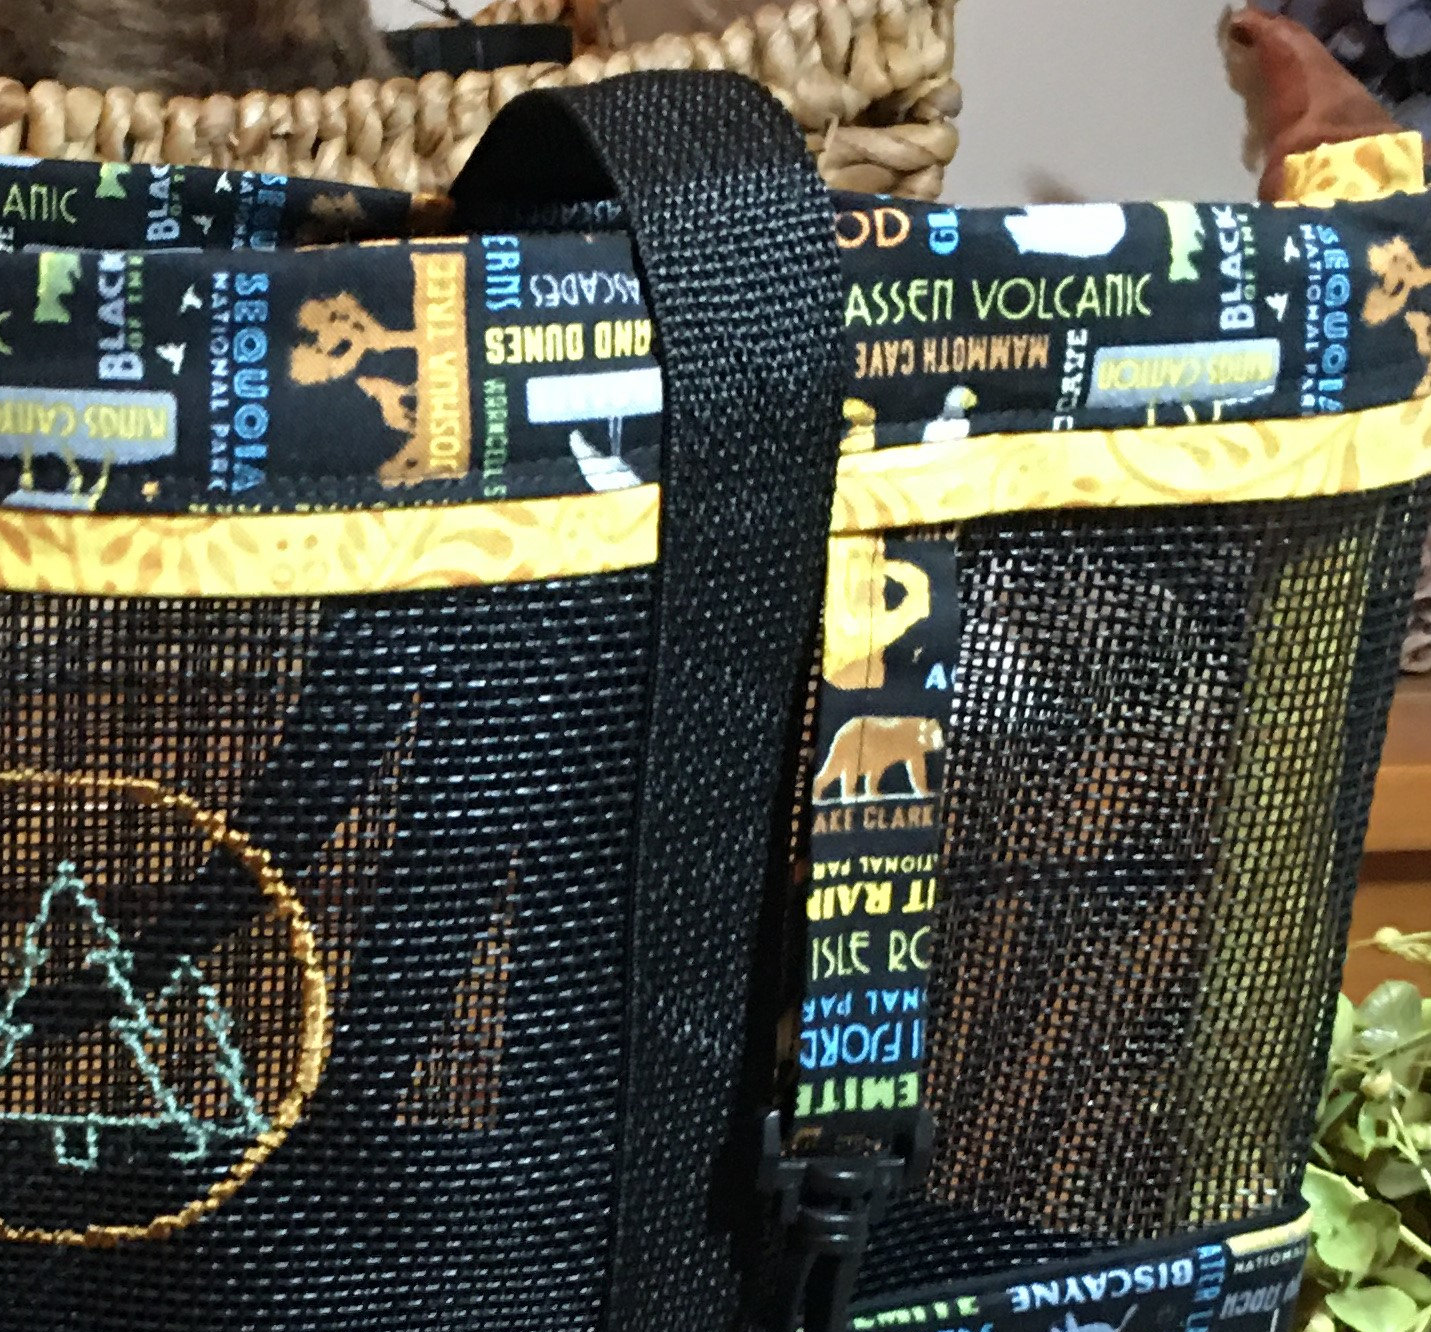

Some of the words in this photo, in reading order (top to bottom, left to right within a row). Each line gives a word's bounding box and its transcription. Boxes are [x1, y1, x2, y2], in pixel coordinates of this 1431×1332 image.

[845, 276, 953, 326] ASSEN
[972, 273, 1152, 320] VOLCANIC
[210, 271, 232, 417] NATIONAL
[854, 341, 917, 379] CAVE
[923, 334, 1051, 374] MAMMOTH
[232, 271, 268, 492] SEQUOIA
[812, 931, 871, 981] ISLE
[1009, 1259, 1194, 1314] BISCAYNE
